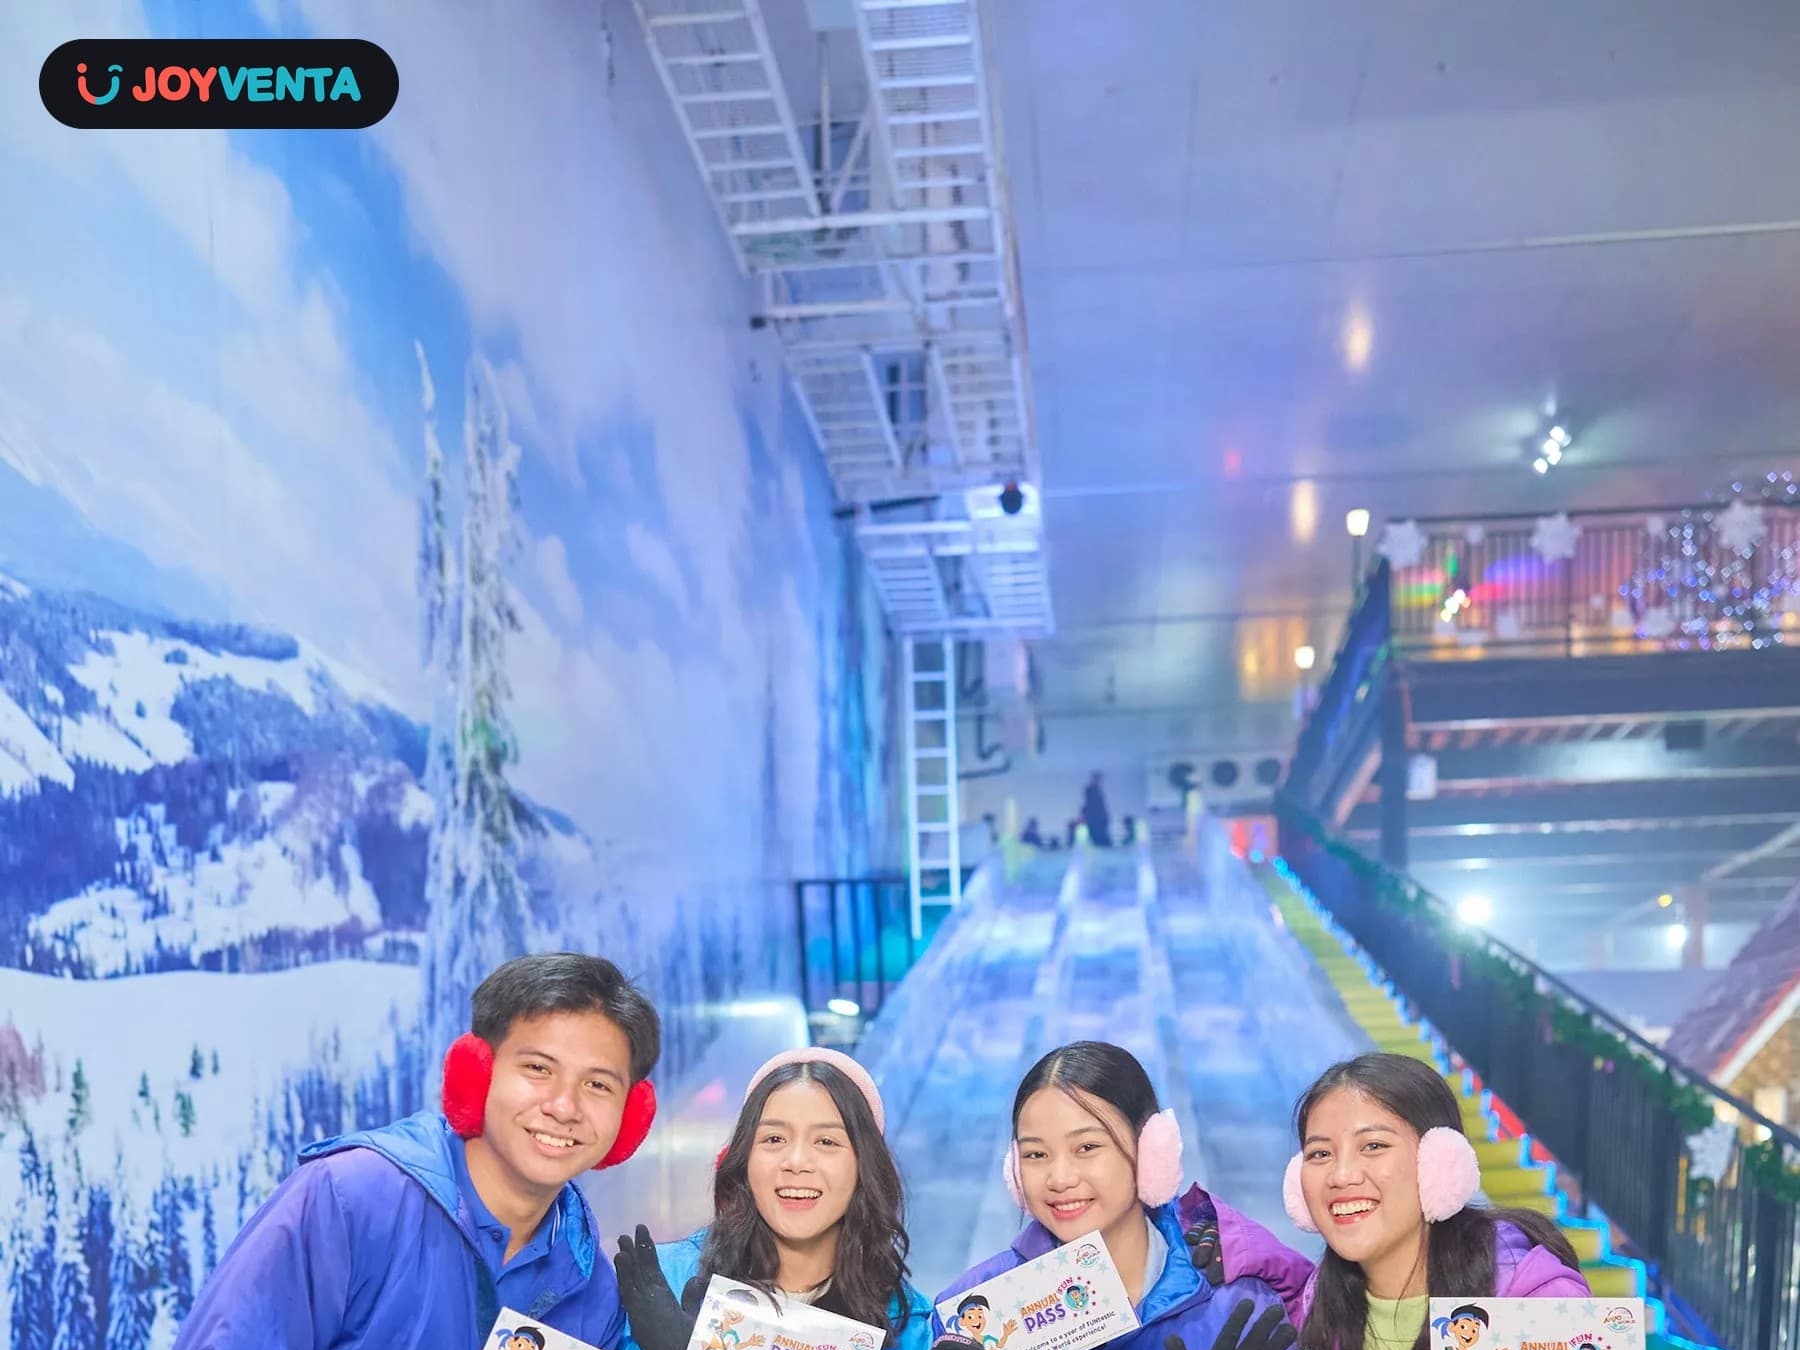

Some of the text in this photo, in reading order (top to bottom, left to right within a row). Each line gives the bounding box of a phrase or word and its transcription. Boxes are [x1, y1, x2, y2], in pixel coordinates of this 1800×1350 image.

[1057, 1277, 1074, 1295] FUN
[1020, 1292, 1061, 1318] ANNUAL
[1024, 1303, 1067, 1332] PASS
[1052, 1340, 1071, 1350] World
[1071, 1323, 1108, 1344] experience!
[1064, 1328, 1078, 1339] year
[1086, 1311, 1116, 1328] FUNtastic
[1570, 1333, 1593, 1347] FUN
